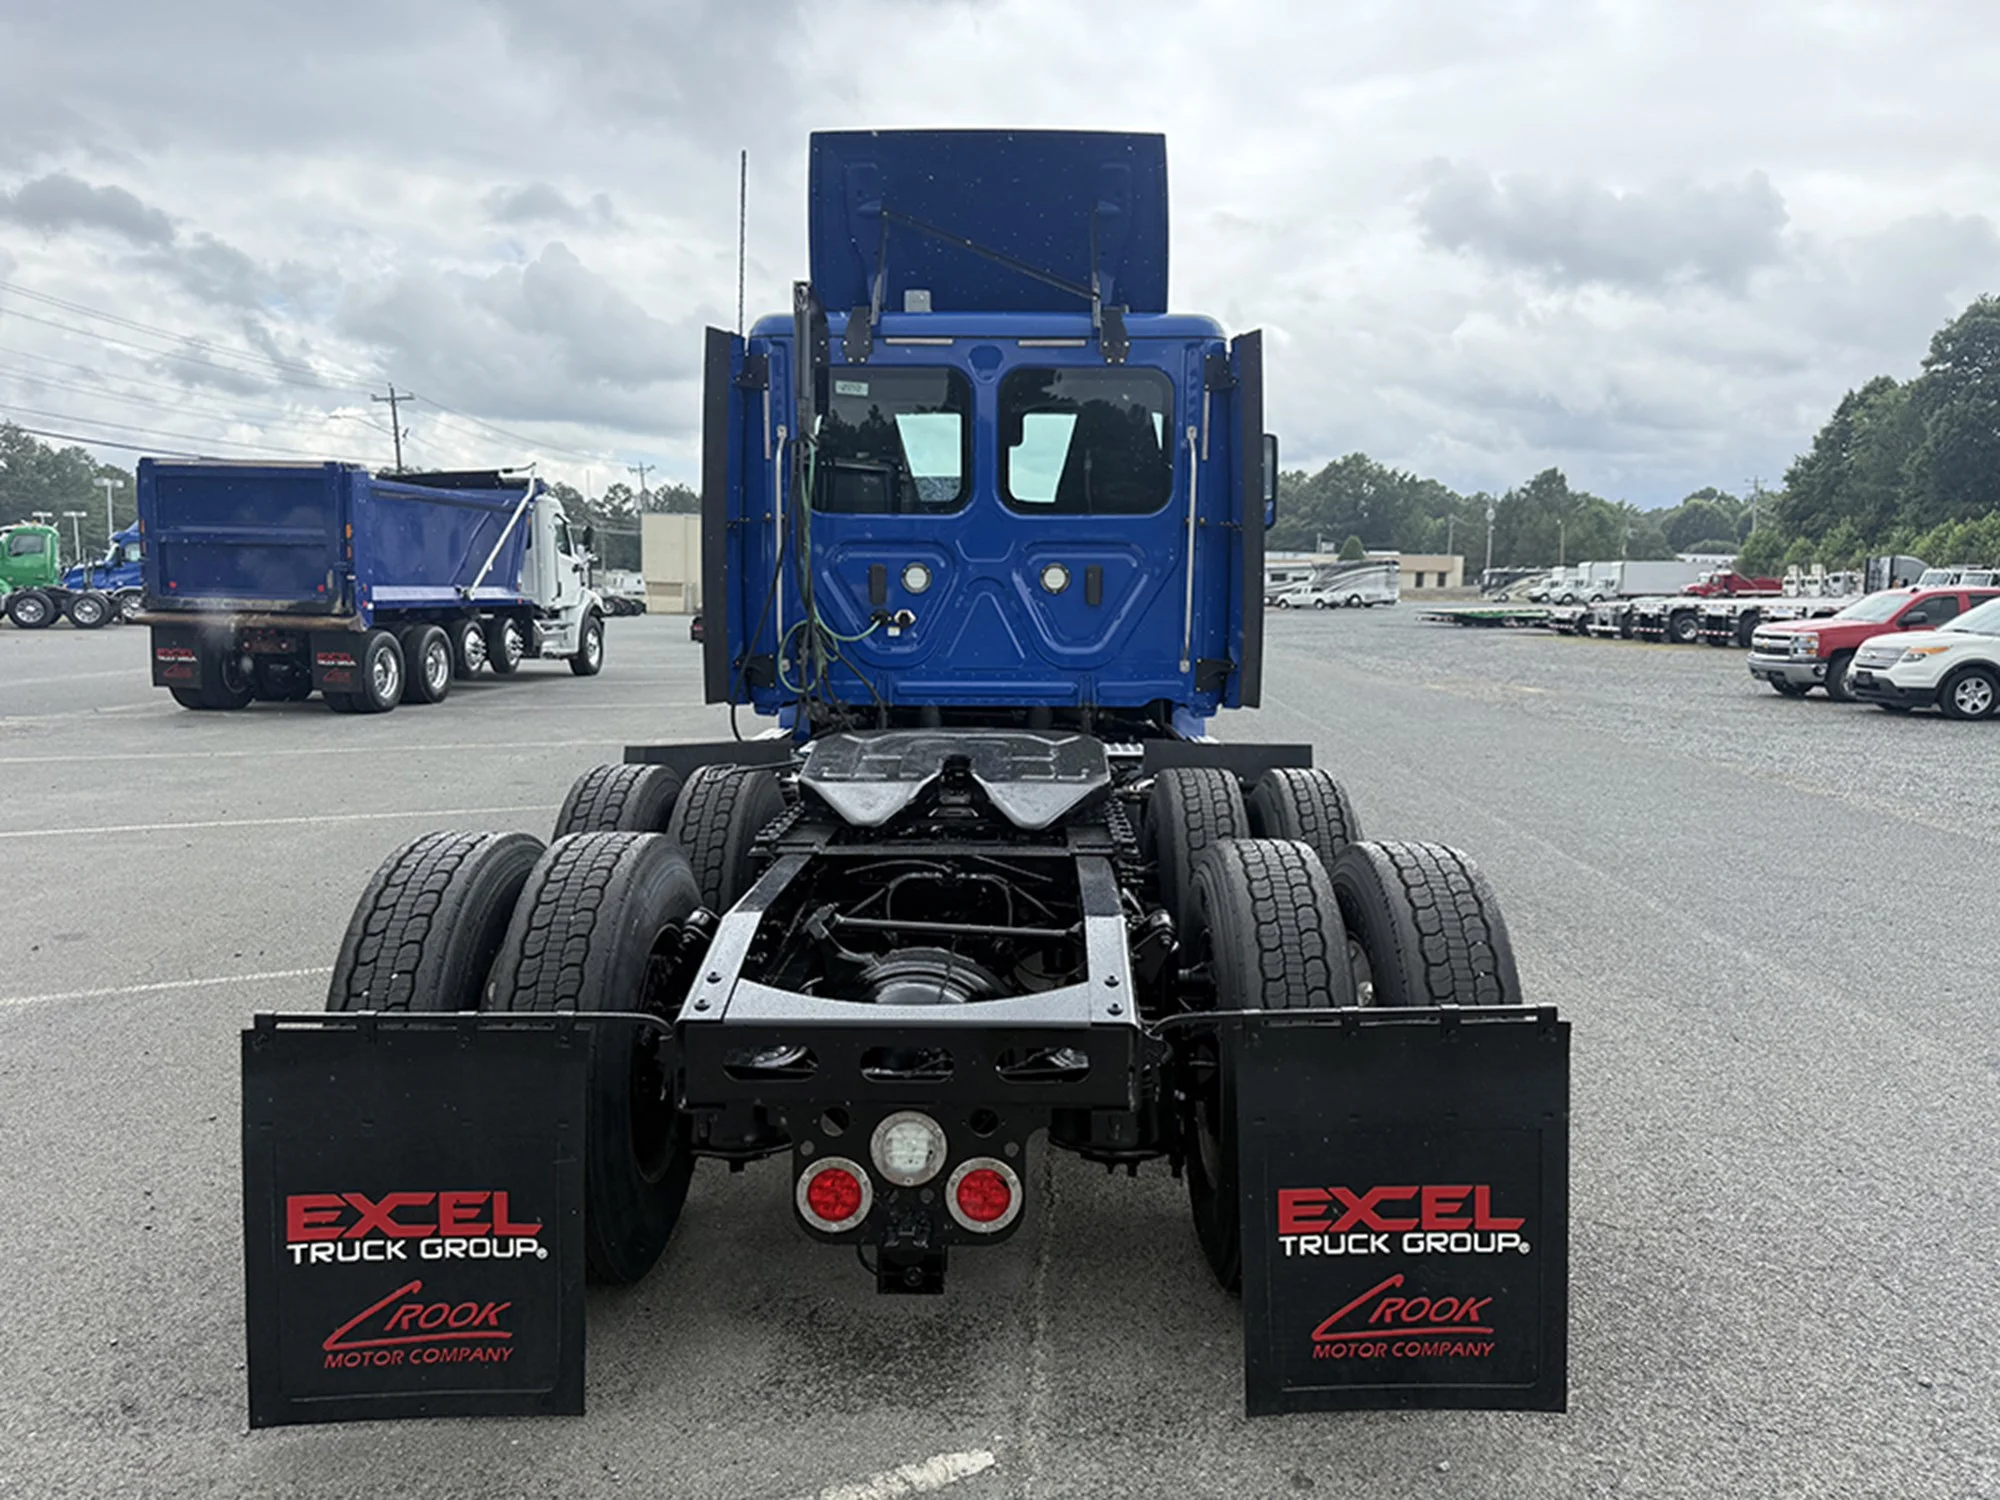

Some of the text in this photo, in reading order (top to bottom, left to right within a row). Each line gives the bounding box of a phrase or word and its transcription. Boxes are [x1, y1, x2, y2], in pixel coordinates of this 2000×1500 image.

[286, 1191, 543, 1242] EXCEL
[1277, 1185, 1525, 1234] EXCEL
[286, 1239, 408, 1265] TRUCK
[1278, 1233, 1391, 1257] TRUCK
[324, 1347, 514, 1369] MOTOR COMPANY
[1312, 1341, 1495, 1359] MOTOR COMPANY
